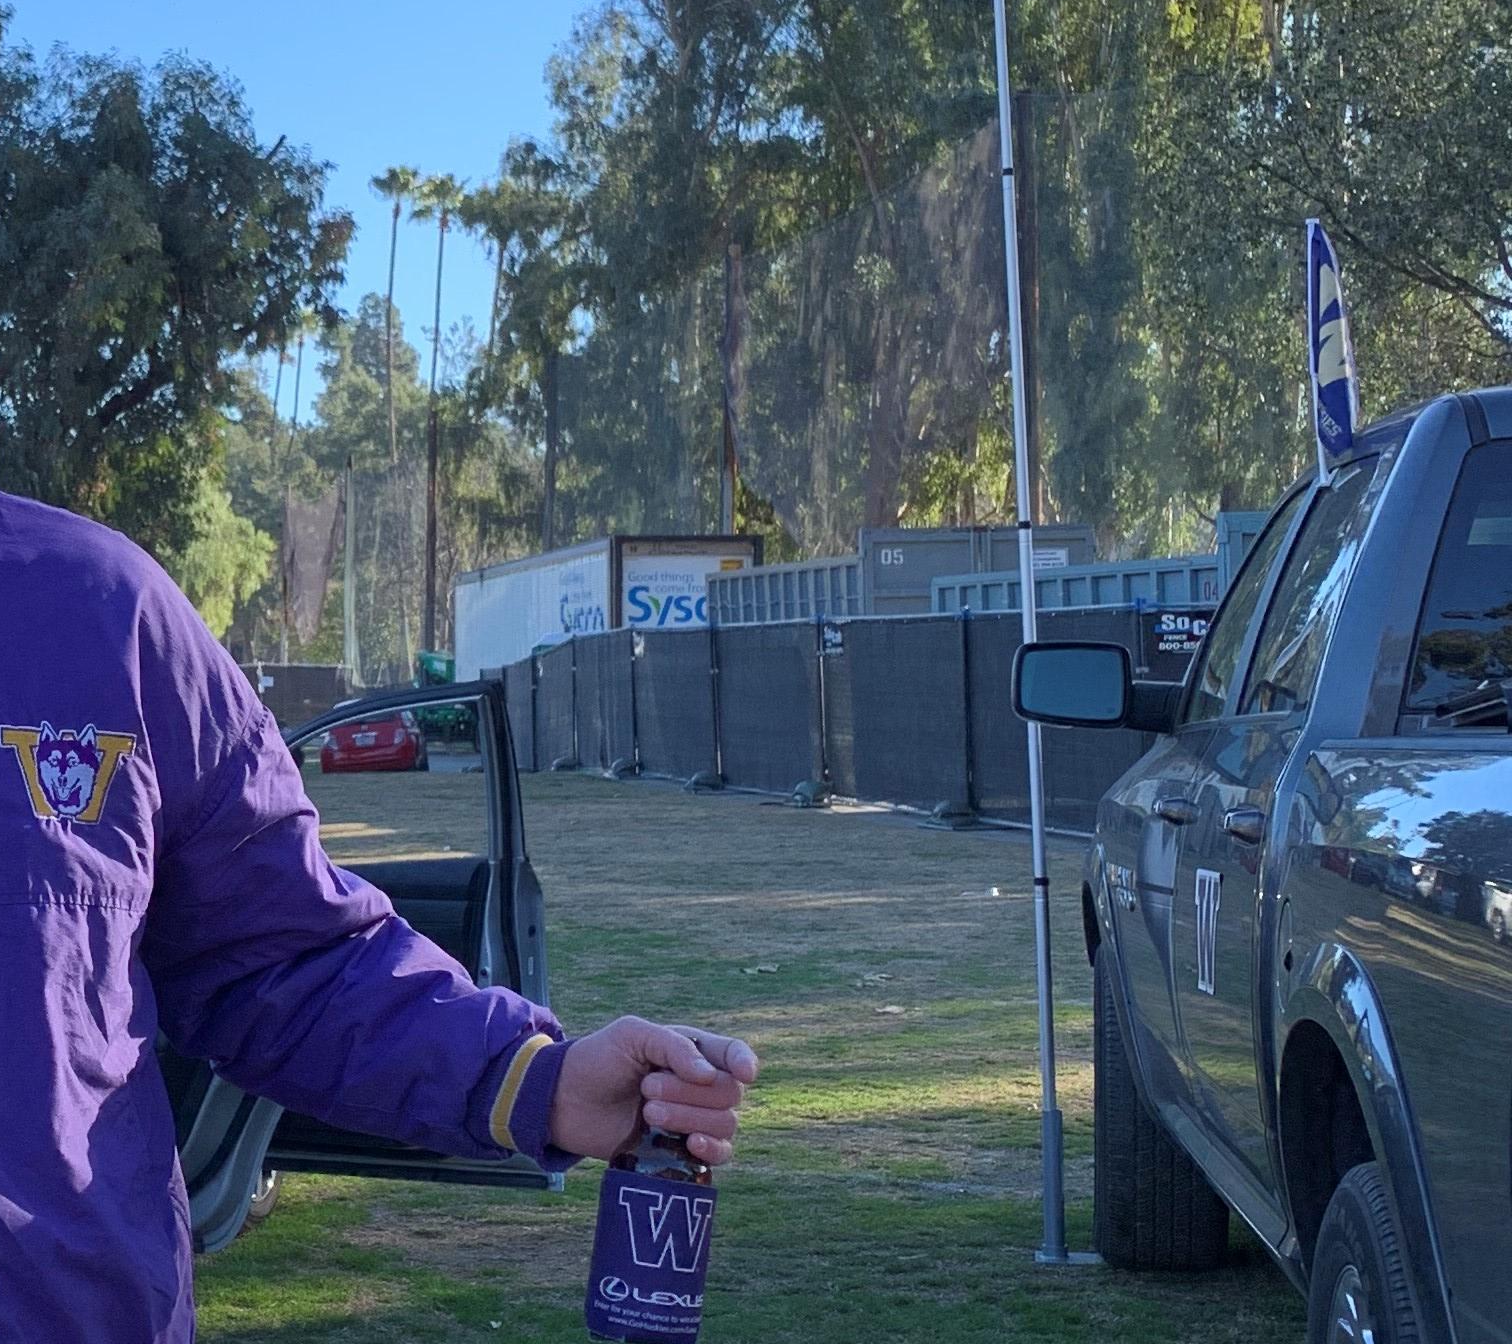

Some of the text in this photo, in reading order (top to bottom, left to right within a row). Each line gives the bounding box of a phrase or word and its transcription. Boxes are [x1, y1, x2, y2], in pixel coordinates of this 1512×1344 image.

[881, 548, 904, 565] 05
[628, 570, 695, 583] Good things
[688, 582, 707, 594] fro
[628, 586, 707, 625] Sysc
[1161, 614, 1208, 636] So C
[619, 1187, 713, 1273] W
